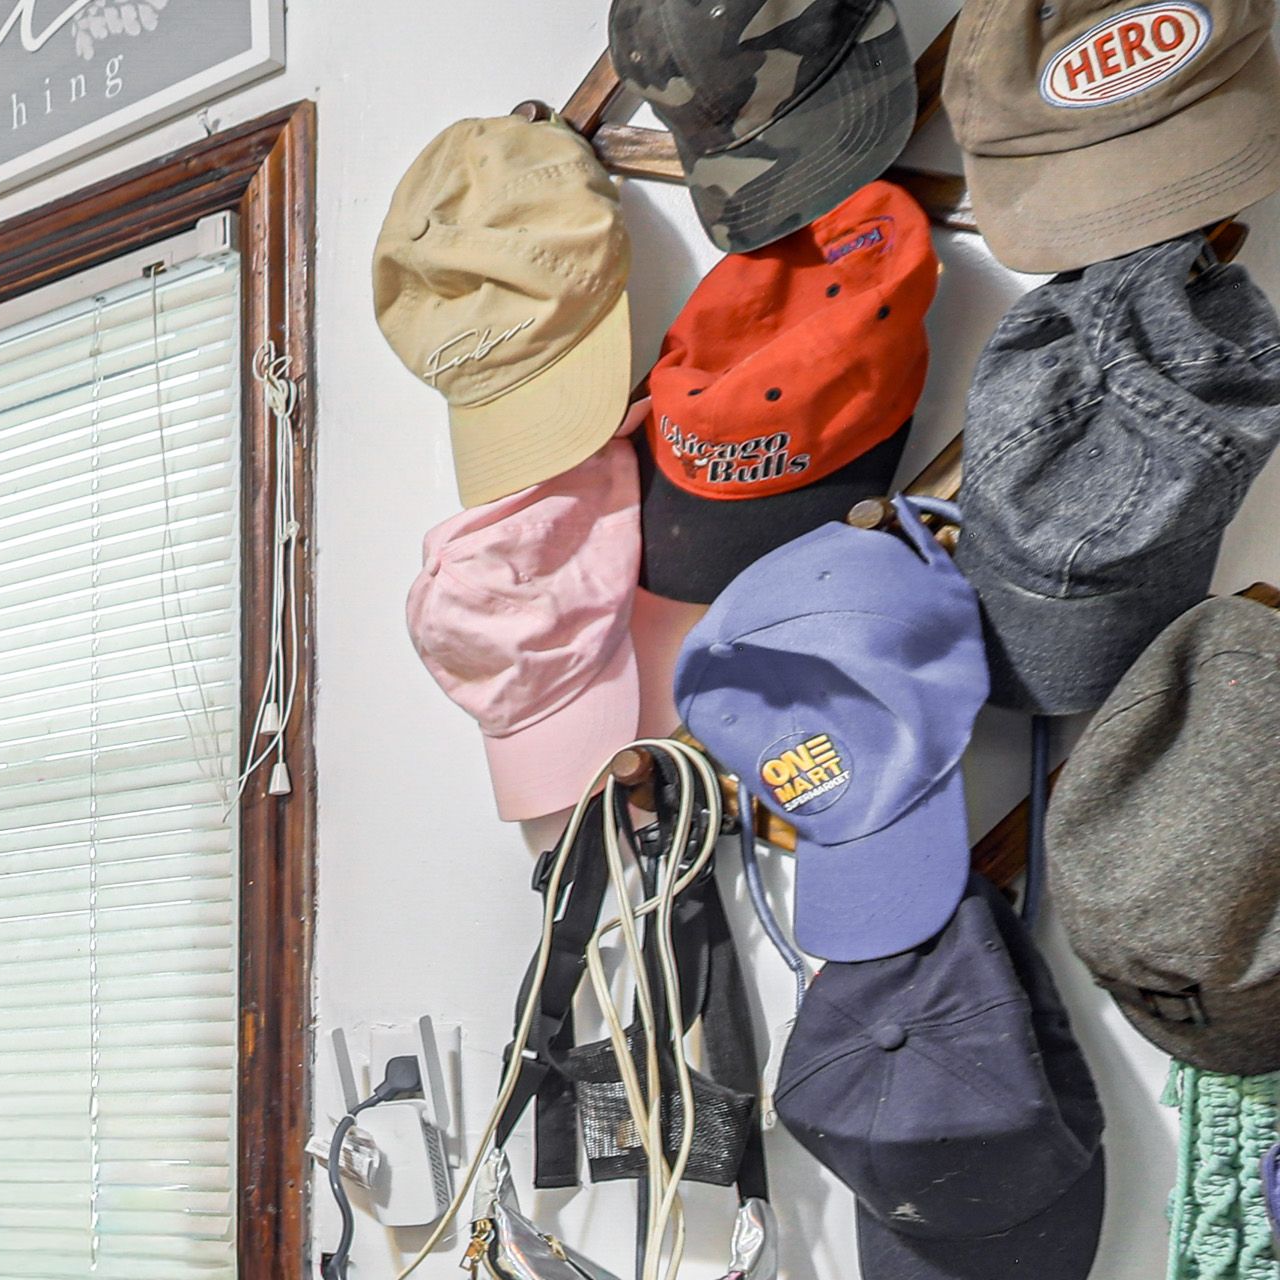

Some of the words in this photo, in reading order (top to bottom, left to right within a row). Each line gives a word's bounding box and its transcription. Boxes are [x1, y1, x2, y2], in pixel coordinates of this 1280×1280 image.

[1063, 14, 1185, 91] HERO
[659, 414, 791, 460] Chicago
[707, 450, 811, 484] Bulls
[761, 733, 837, 787] ONE
[772, 756, 842, 804] MART
